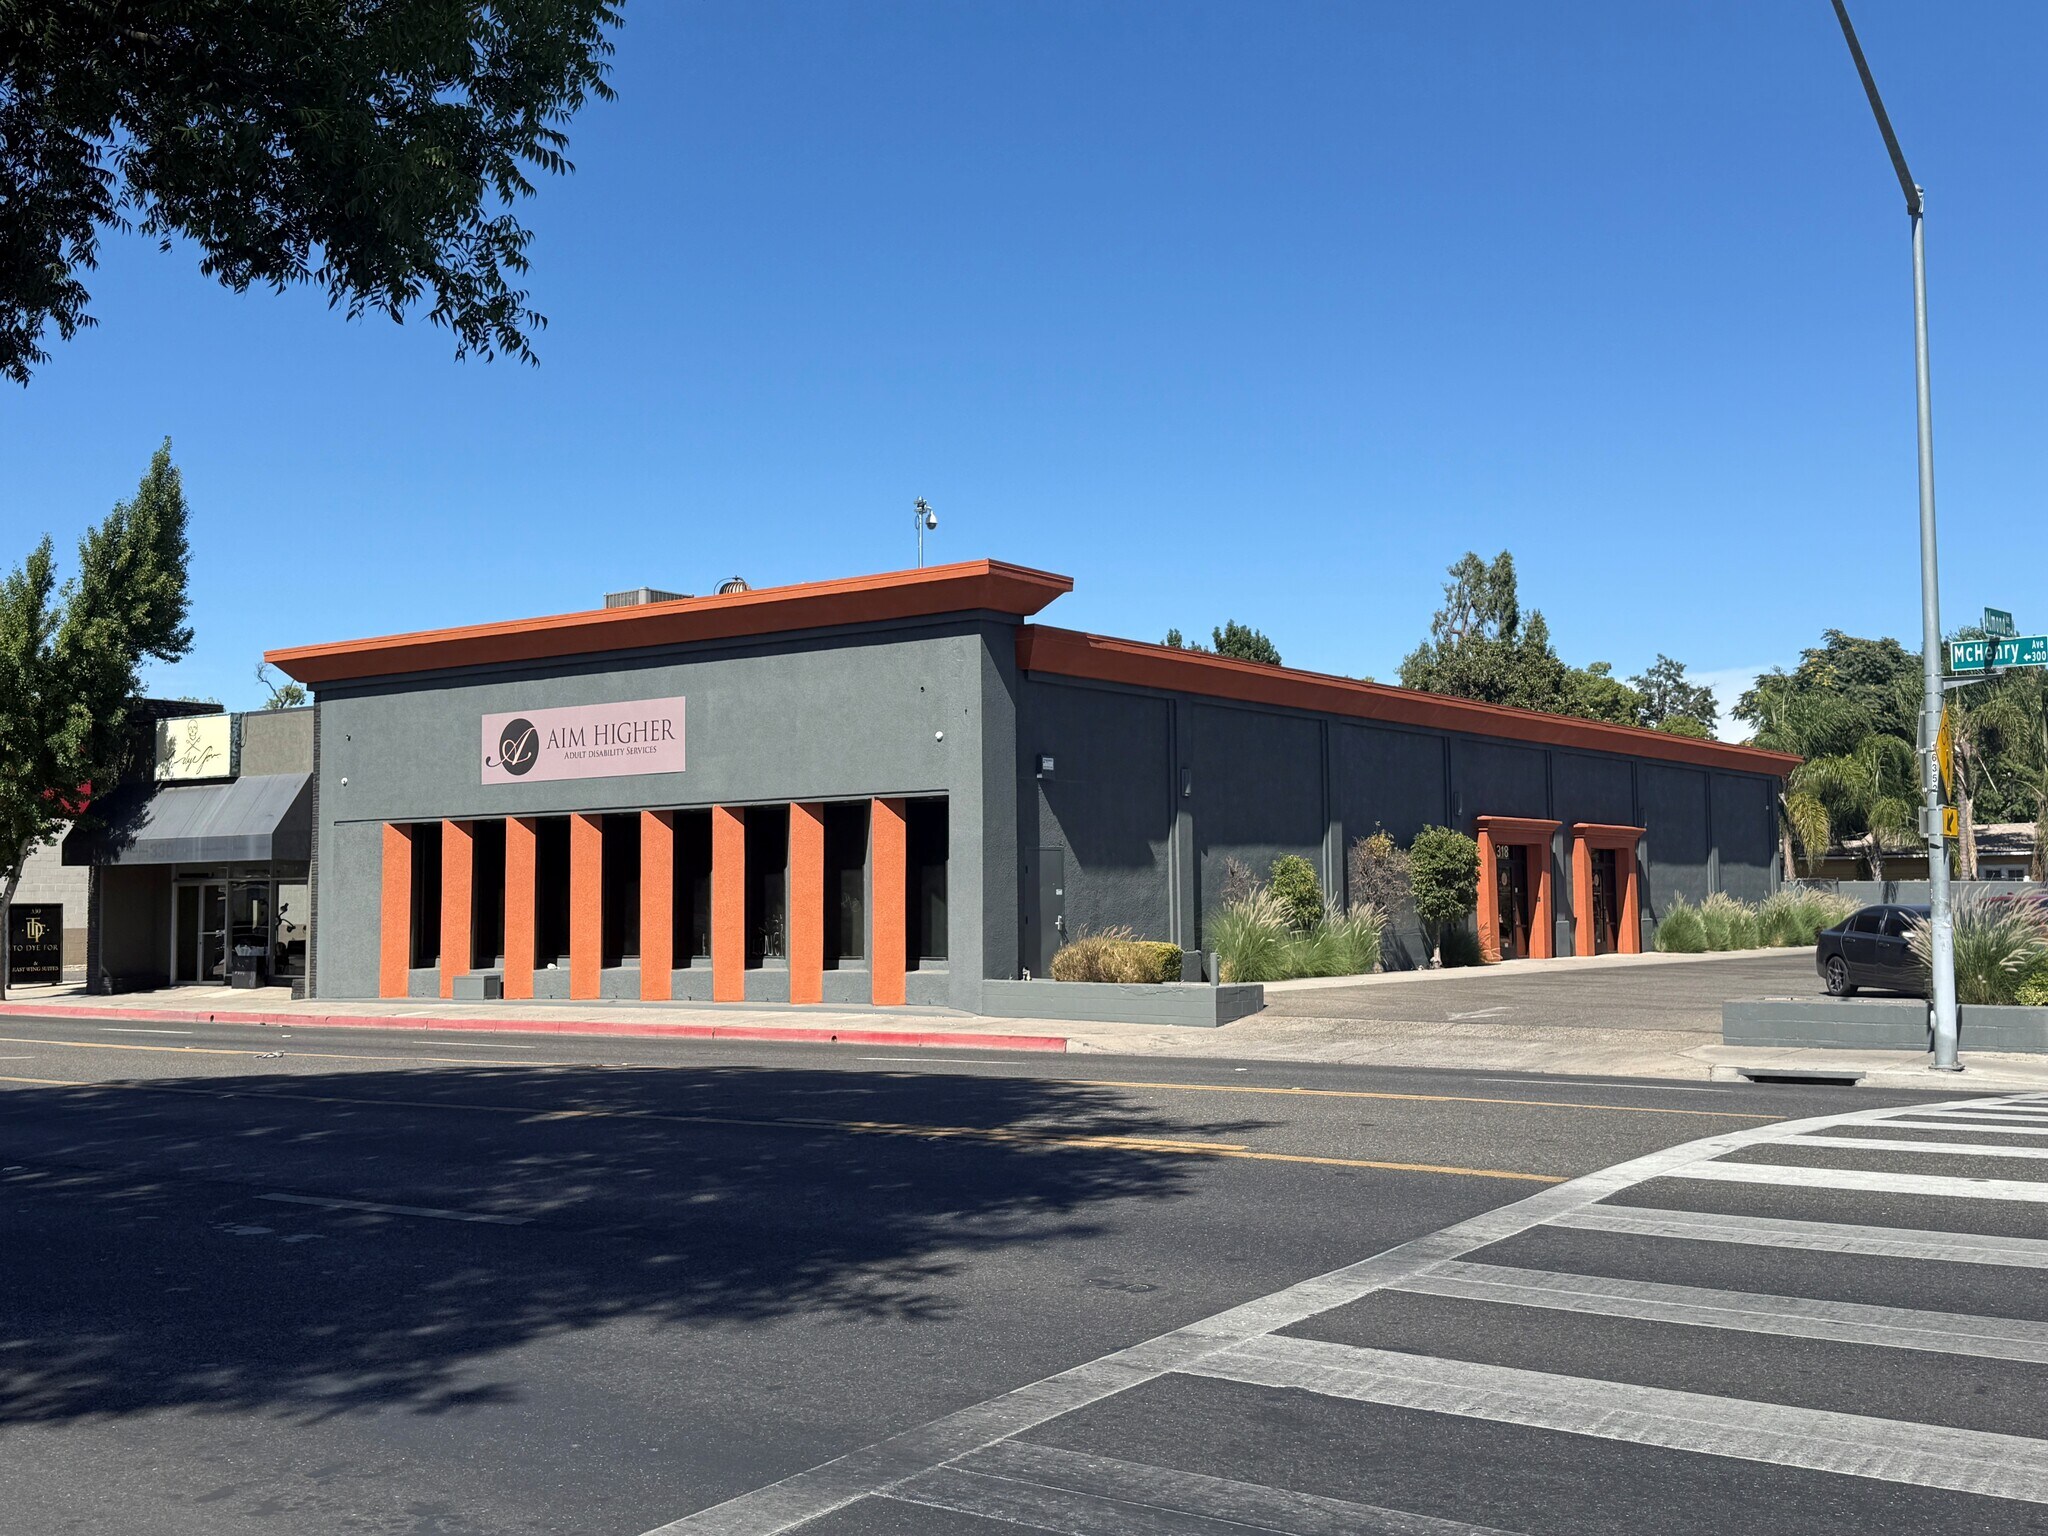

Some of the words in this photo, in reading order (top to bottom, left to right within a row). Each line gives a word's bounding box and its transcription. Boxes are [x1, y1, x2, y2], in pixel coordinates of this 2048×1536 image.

[1954, 643, 2019, 663] McHenry
[2031, 640, 2044, 649] Ave
[2031, 650, 2046, 661] 300
[546, 727, 586, 749] AIM
[594, 719, 676, 746] HIGHER
[1496, 845, 1509, 857] 318
